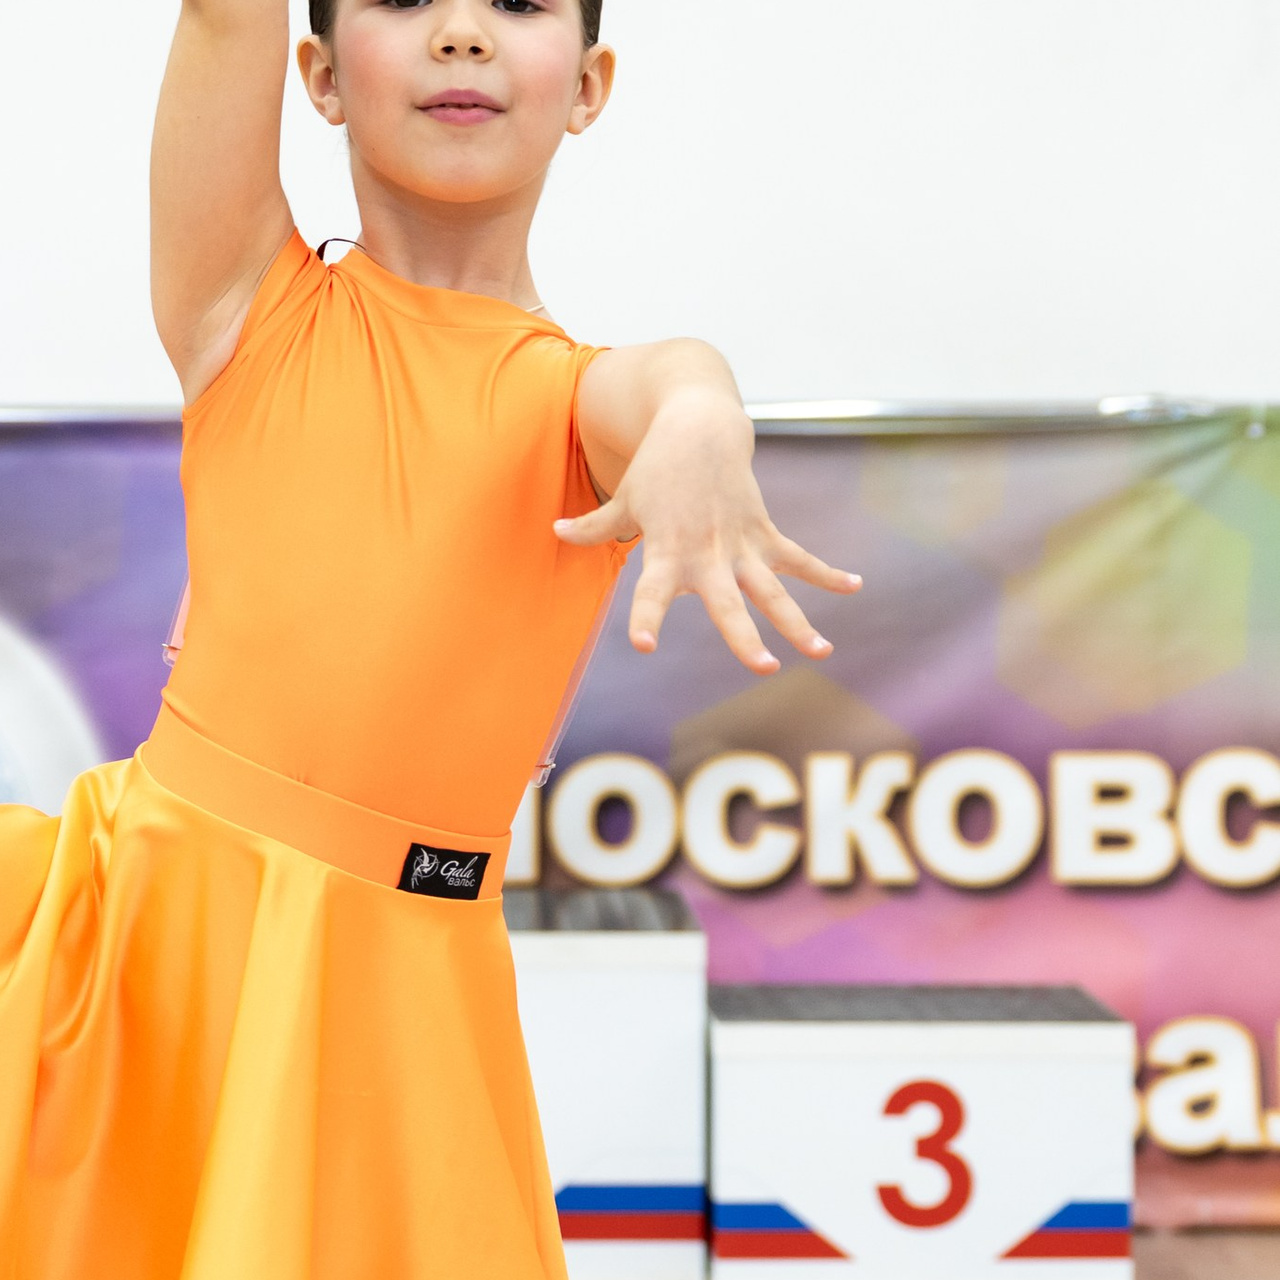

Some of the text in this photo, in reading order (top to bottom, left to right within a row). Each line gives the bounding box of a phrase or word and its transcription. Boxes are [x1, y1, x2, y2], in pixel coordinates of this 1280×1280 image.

[440, 855, 479, 881] Gala
[447, 876, 476, 888] вальс
[874, 1077, 976, 1228] 3
